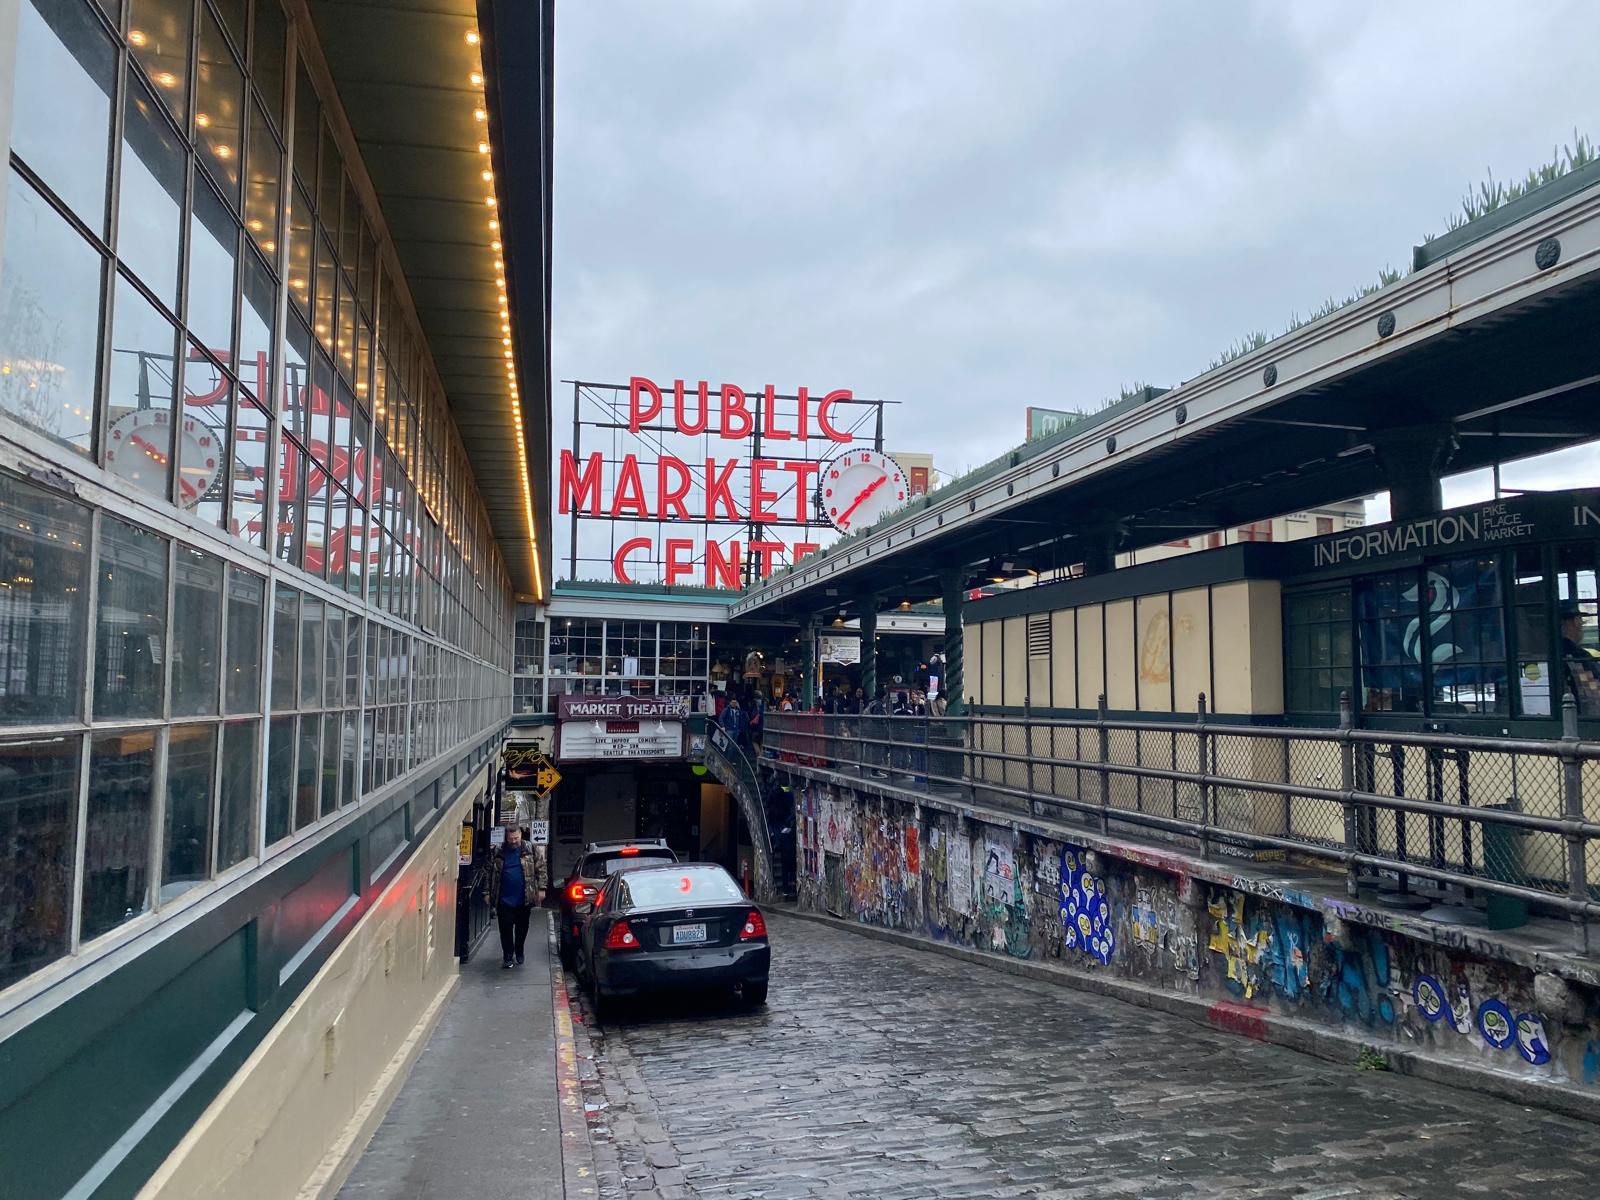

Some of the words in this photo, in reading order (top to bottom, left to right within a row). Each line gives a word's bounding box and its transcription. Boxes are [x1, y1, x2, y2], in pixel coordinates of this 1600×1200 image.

[628, 376, 853, 444] PUBLIC
[861, 453, 871, 462] 12
[558, 448, 820, 523] MARKET
[1482, 504, 1507, 516] PIKE
[1483, 513, 1522, 528] PLACE
[1313, 512, 1480, 567] INFORMATION
[1484, 523, 1535, 541] MARKET
[570, 703, 622, 715] MARKET
[627, 703, 680, 715] THEATER
